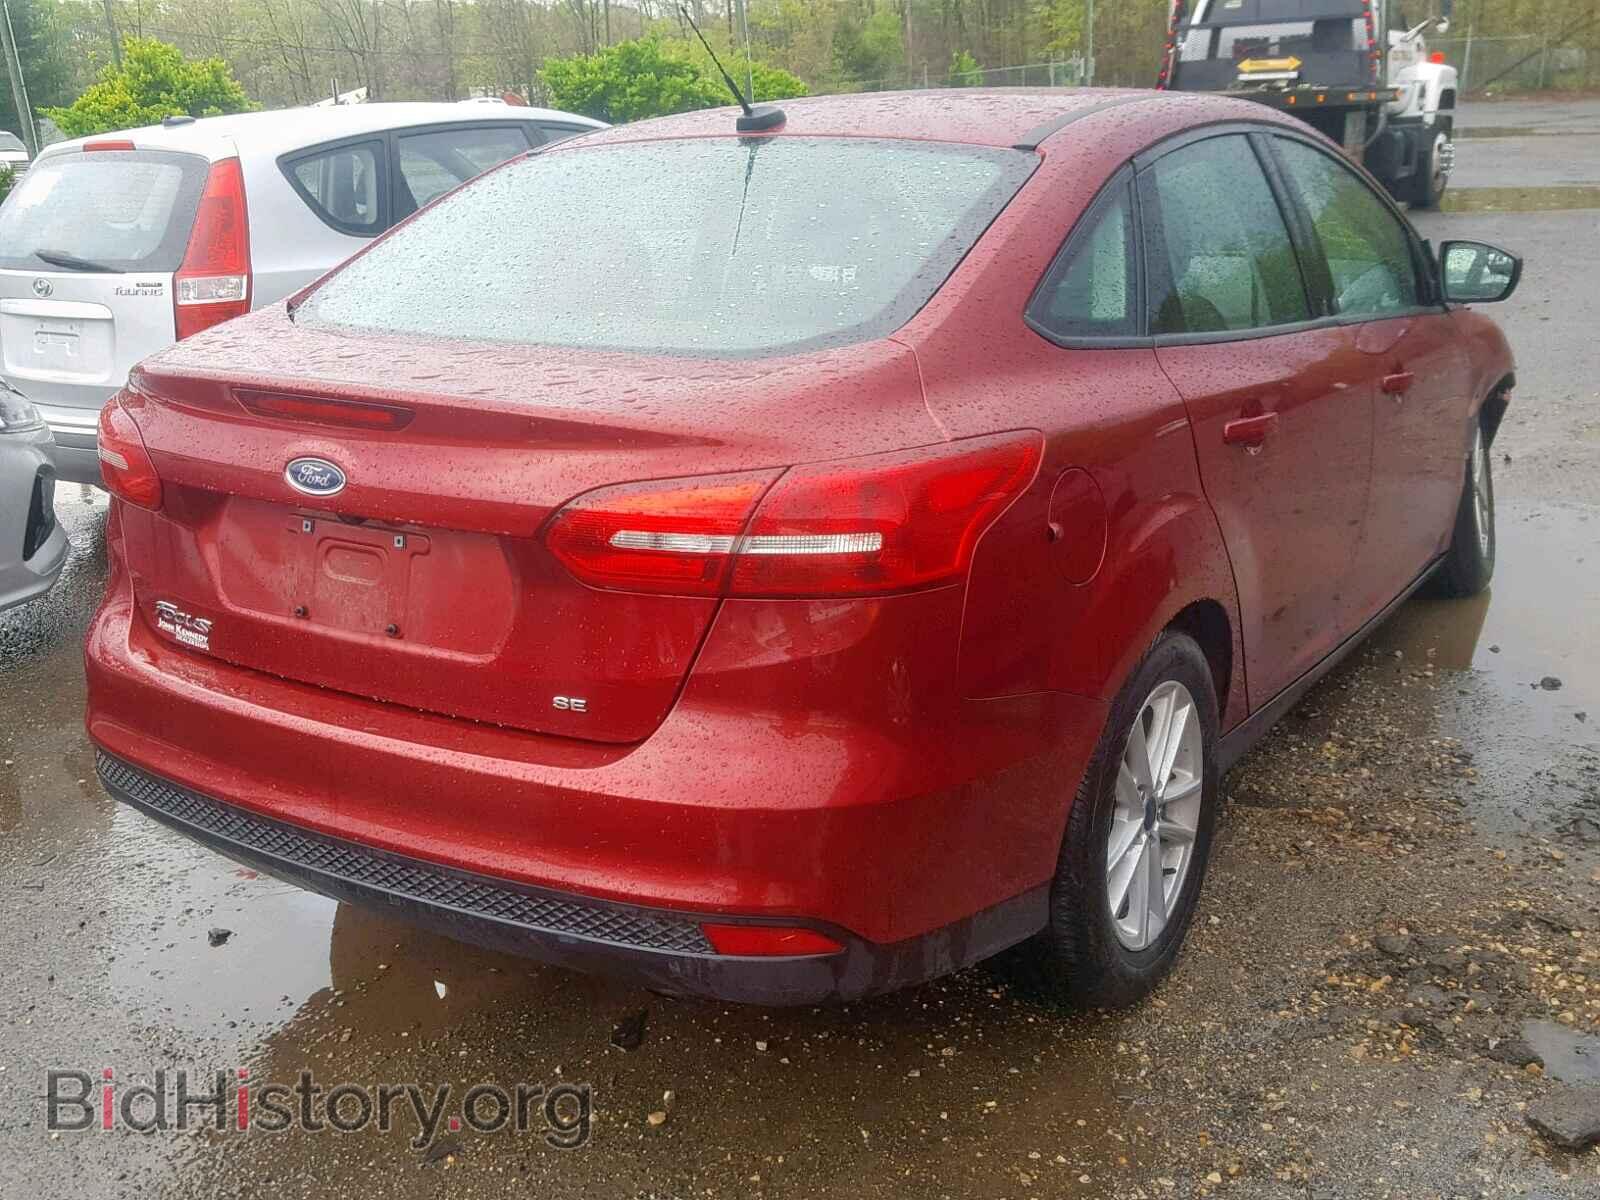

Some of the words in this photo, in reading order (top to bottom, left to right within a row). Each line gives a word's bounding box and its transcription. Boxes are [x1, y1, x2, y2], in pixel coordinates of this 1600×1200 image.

[298, 464, 331, 487] Ford
[175, 624, 208, 643] KENNEDY
[552, 696, 587, 712] SE
